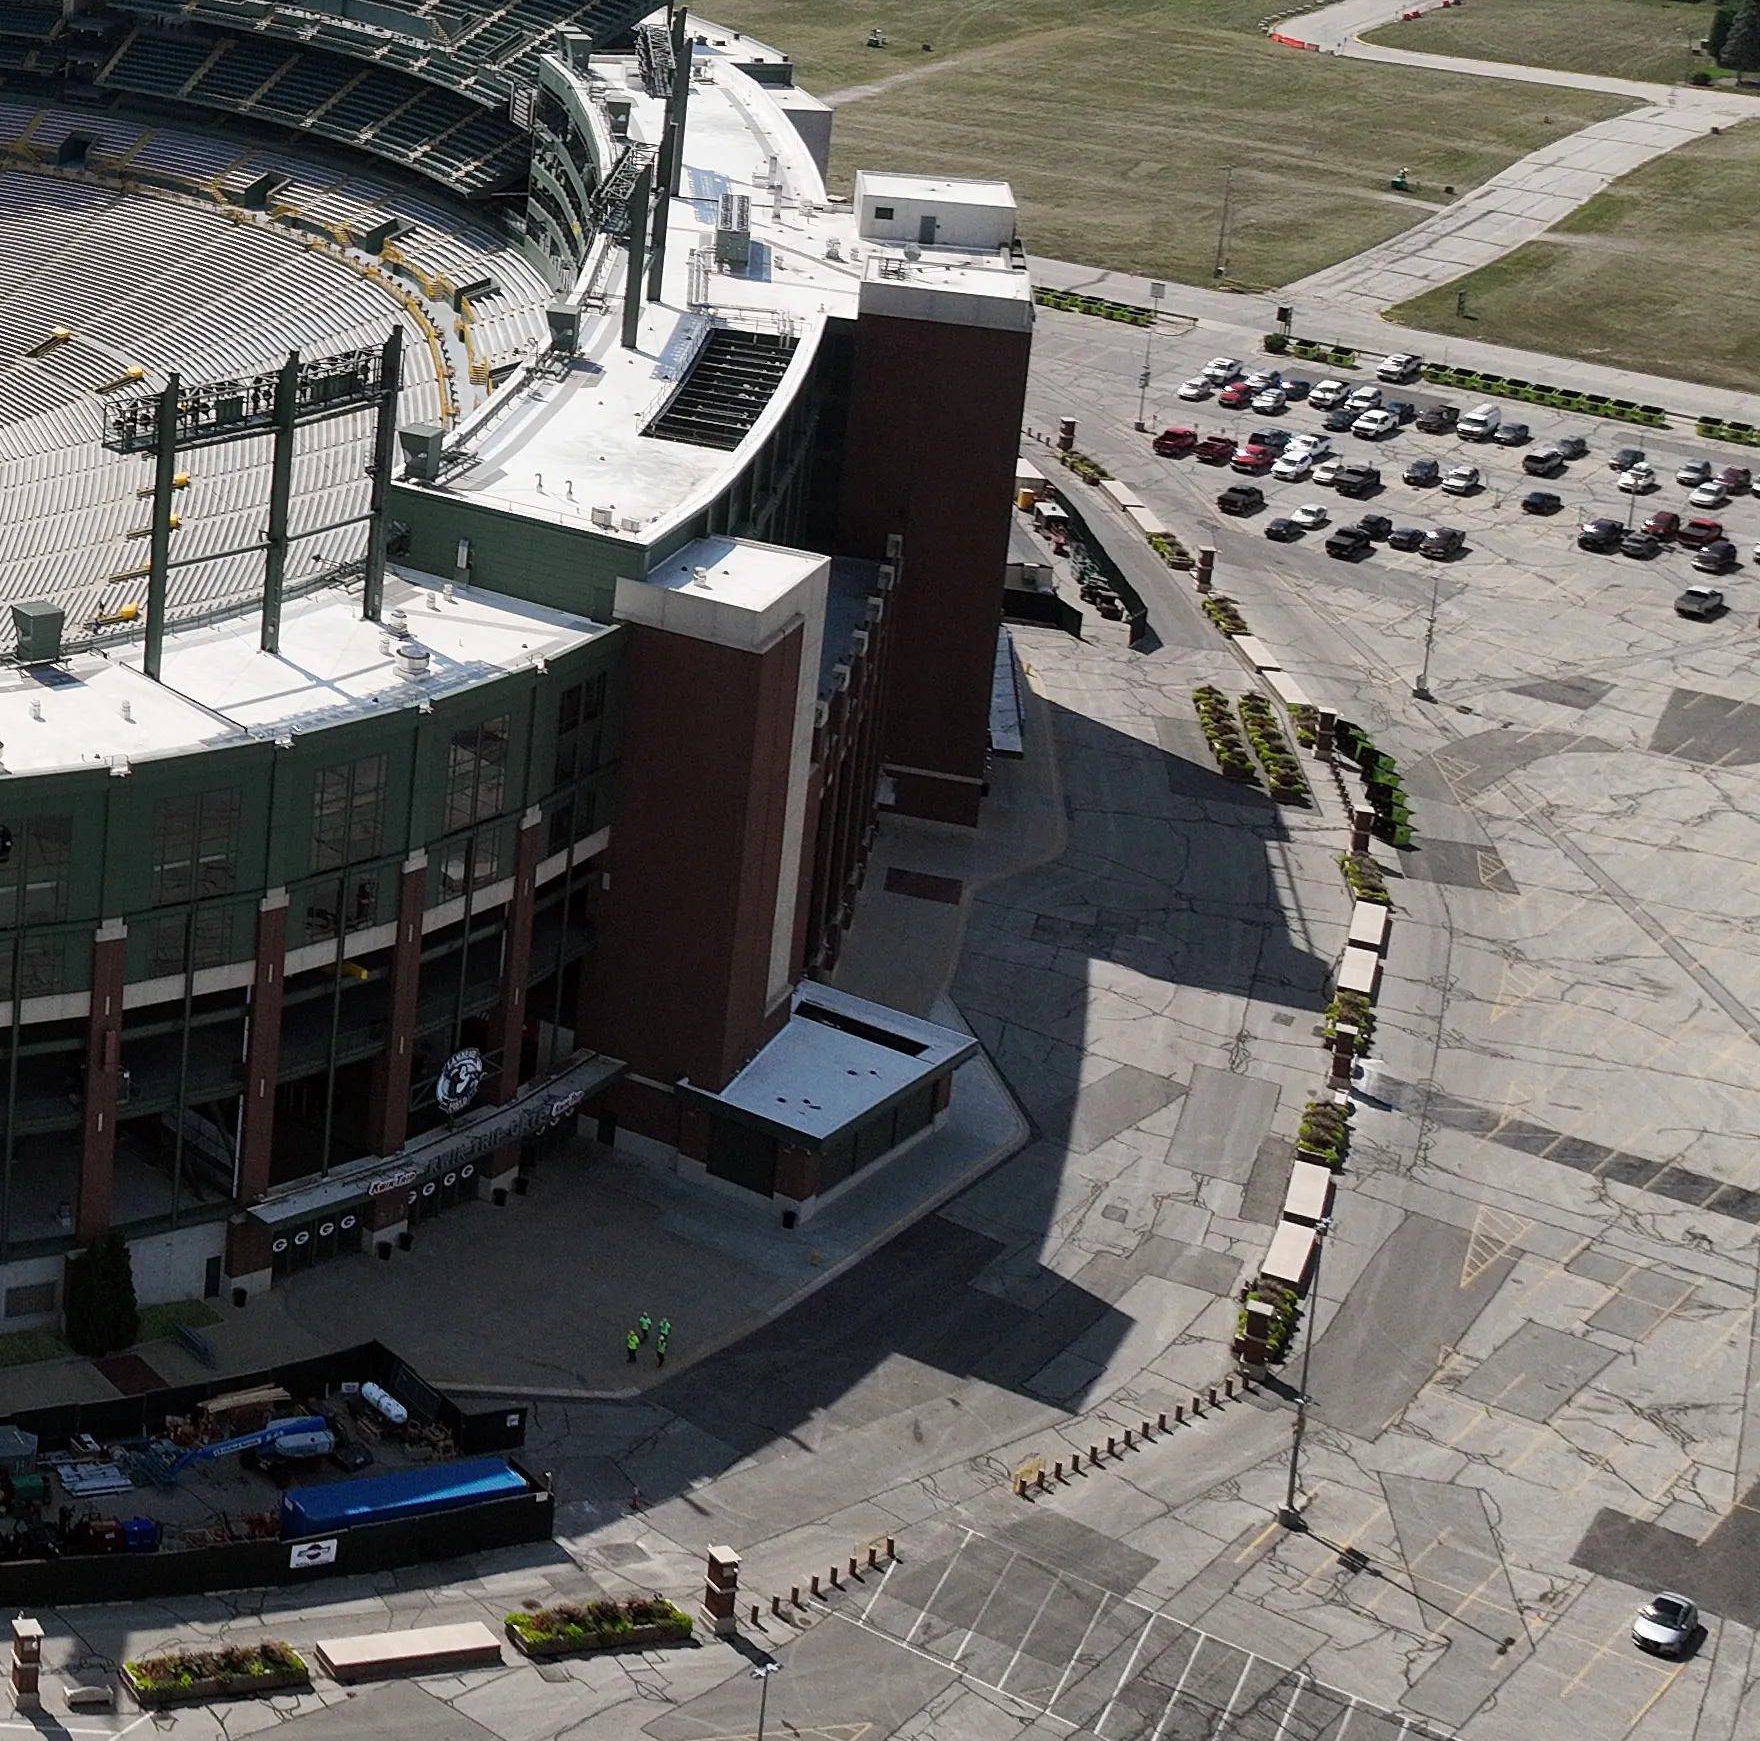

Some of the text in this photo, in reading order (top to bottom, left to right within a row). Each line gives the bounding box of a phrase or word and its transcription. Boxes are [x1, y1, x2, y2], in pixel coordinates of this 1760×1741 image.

[429, 1111, 550, 1176] KWIK TRIP GATE
